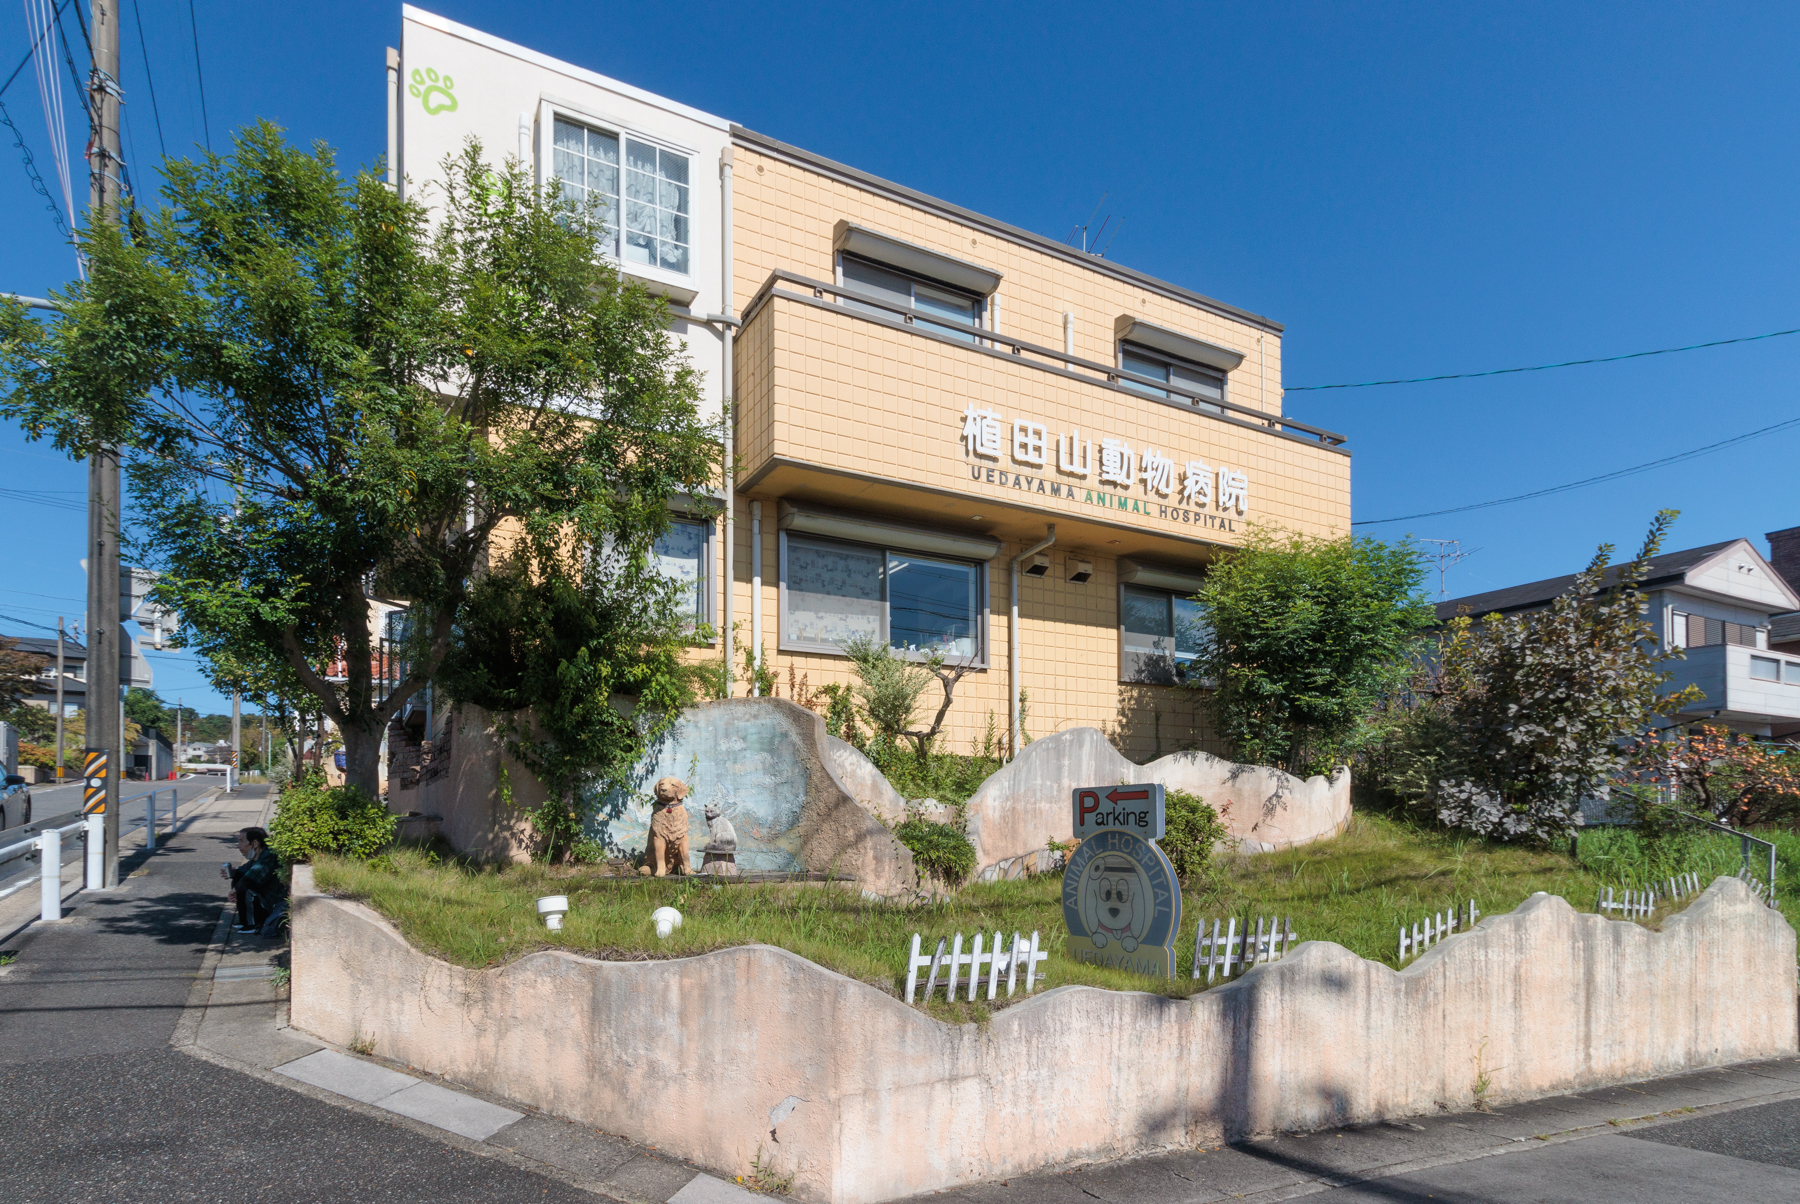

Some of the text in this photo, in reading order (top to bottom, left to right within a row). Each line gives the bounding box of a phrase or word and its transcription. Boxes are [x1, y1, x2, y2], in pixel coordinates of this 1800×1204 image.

[962, 402, 1249, 512] 植田山動物病院
[971, 465, 1236, 533] UEDAYAMA ANIMAL HOSPITAL
[1079, 791, 1149, 828] Parking
[1065, 833, 1170, 918] ANIMAL HOSPITAL
